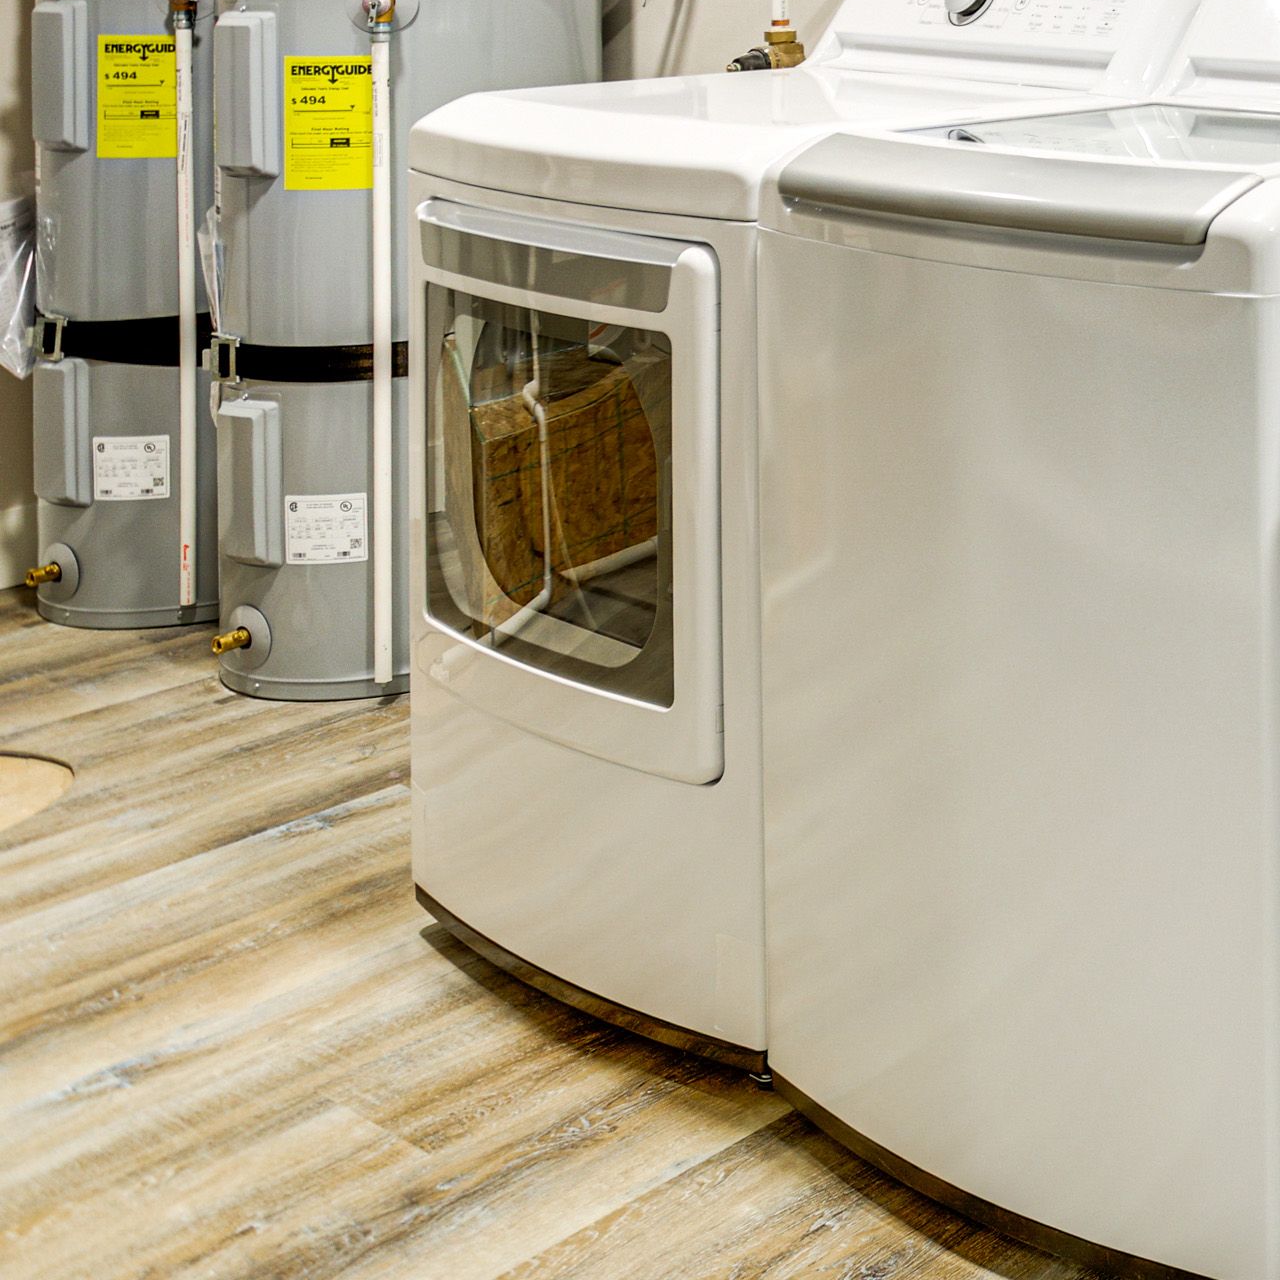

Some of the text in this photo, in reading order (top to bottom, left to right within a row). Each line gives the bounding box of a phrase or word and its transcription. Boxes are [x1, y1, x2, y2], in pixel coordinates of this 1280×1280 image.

[104, 43, 176, 58] ENERGYGUID
[113, 71, 137, 80] 494
[291, 64, 372, 80] ENERGYGUIDE
[300, 95, 326, 105] 494
